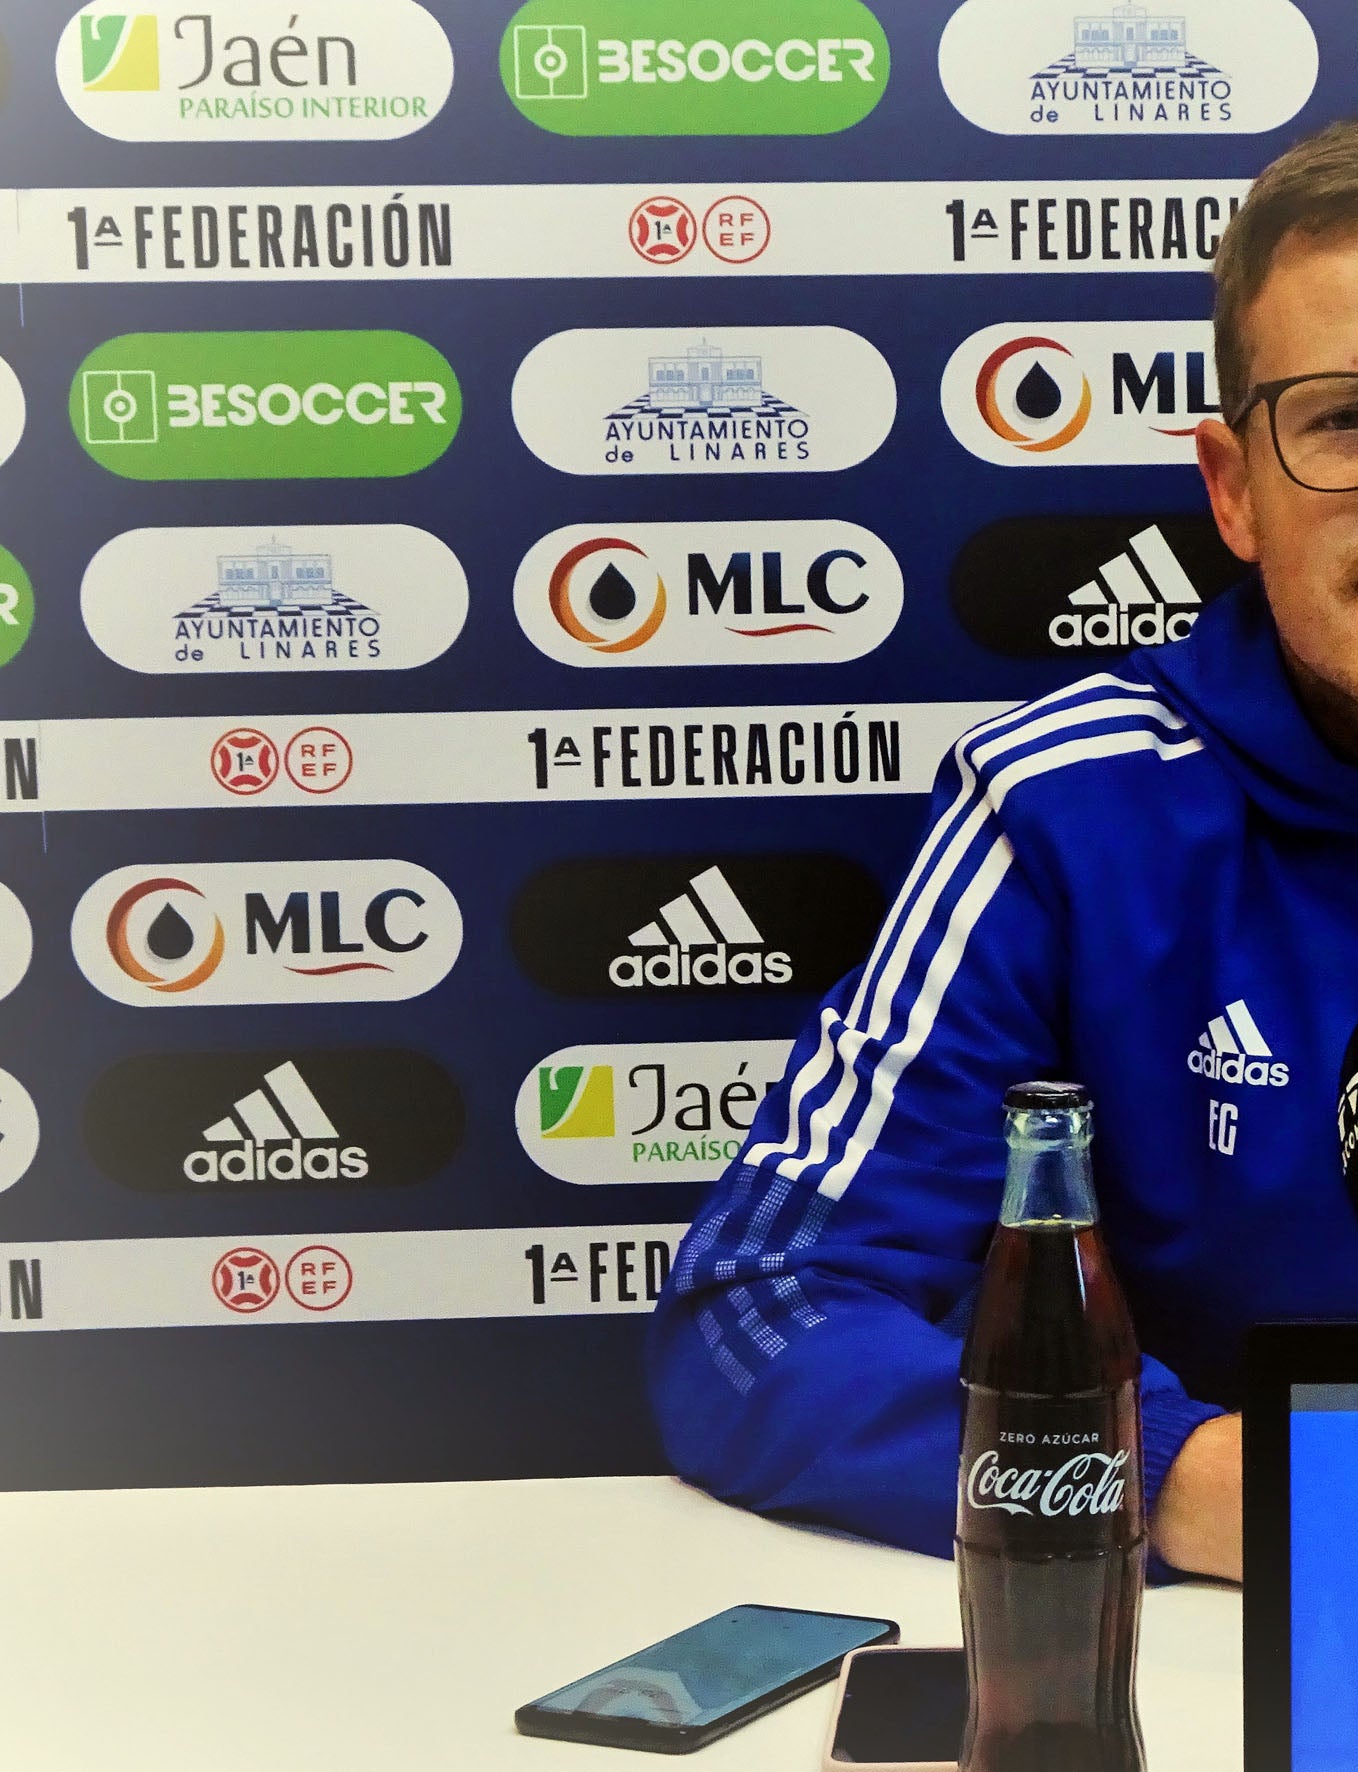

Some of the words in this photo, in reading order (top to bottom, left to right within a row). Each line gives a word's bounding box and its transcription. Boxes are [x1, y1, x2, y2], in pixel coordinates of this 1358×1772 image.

[175, 15, 356, 89] Jaén
[598, 39, 874, 83] BESOCCER
[180, 91, 293, 118] PARAÍSO
[303, 97, 428, 118] INTERIOR
[1031, 81, 1231, 100] AYUNTAMIENTO
[1031, 105, 1058, 123] de
[1095, 103, 1231, 121] LINARES
[135, 193, 451, 269] FEDERACIÓN
[1010, 194, 1240, 260] FEDERAC
[168, 382, 446, 427] BESOCCER
[1112, 351, 1224, 415] ML
[606, 419, 808, 440] AYUNTAMIENTO
[605, 445, 634, 463] de
[670, 441, 809, 461] LINARES
[688, 550, 869, 615] MLC
[176, 617, 379, 639] AYUNTAMIENTO
[1049, 603, 1199, 646] adida
[175, 644, 203, 661] de
[241, 639, 380, 659] LINARES
[593, 711, 900, 787] FEDERACIÓN
[246, 889, 428, 954] MLC
[608, 943, 793, 988] adidas
[1187, 1049, 1290, 1087] adidas
[629, 1061, 782, 1136] Jaé
[632, 1134, 742, 1163] PARAÍSO
[1209, 1100, 1238, 1155] EG
[183, 1140, 369, 1184] adidas
[1000, 1432, 1035, 1443] ZERO
[1042, 1433, 1099, 1444] AZÚCAR
[968, 1449, 1130, 1516] Coca-Cola
